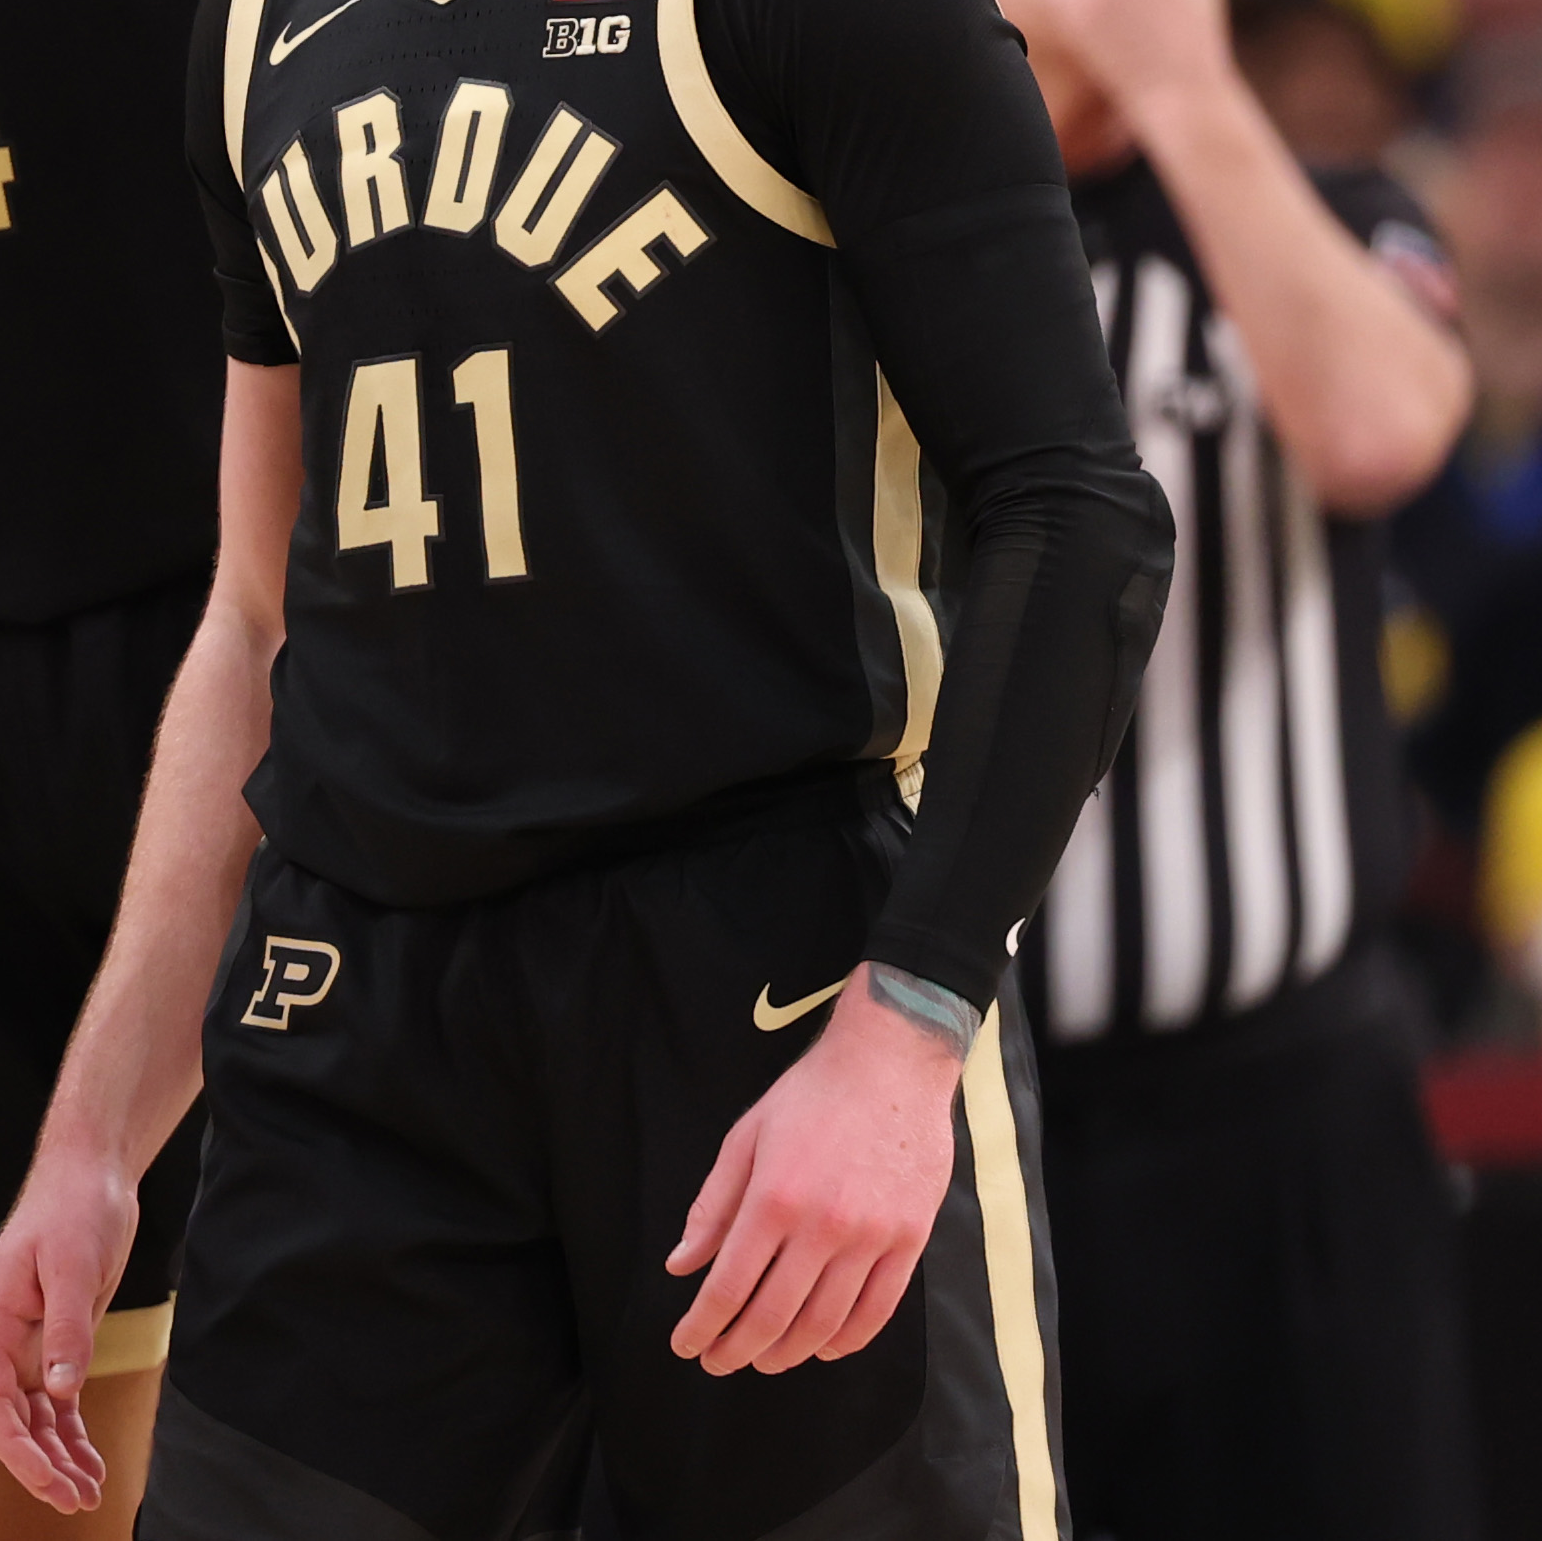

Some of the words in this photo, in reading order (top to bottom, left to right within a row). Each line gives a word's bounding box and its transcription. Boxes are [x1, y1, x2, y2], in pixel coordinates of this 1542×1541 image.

[255, 80, 713, 356] URDUE
[337, 348, 529, 589] 41
[240, 935, 341, 1031] P
